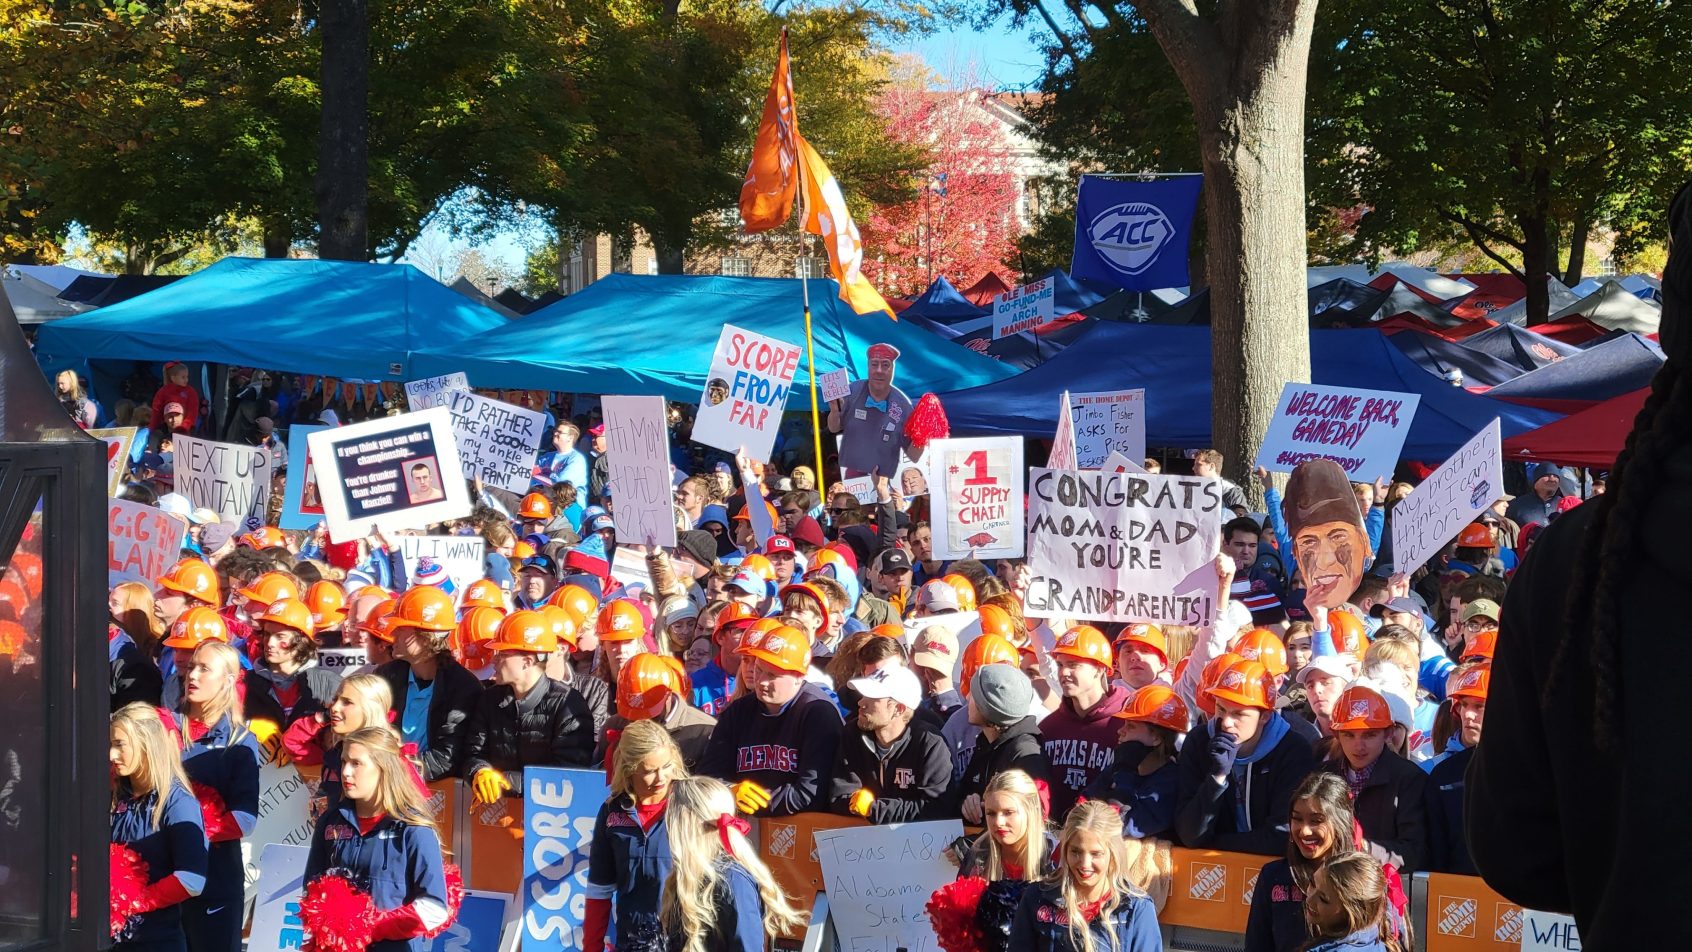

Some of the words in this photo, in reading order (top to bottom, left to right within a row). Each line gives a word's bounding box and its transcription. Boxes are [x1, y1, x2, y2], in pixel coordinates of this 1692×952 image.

[1100, 219, 1165, 244] ACC
[998, 287, 1053, 313] GO-FUND-ME
[1002, 289, 1020, 302] OLE
[1024, 280, 1046, 295] MISS
[1000, 315, 1043, 336] MANNING
[1012, 306, 1038, 323] ARCH
[727, 333, 799, 380] SCORE
[413, 394, 433, 411] NO
[731, 370, 789, 411] FROM
[451, 392, 475, 414] I'D
[478, 402, 533, 437] RATHER
[729, 400, 768, 431] FAR
[1071, 405, 1104, 423] Jimbo
[1110, 404, 1134, 421] Fisher
[1285, 390, 1361, 420] WELCOME
[1358, 398, 1403, 429] BACK,
[449, 411, 481, 434] TAKE
[480, 424, 491, 440] A
[1077, 424, 1106, 438] ASKS
[1114, 422, 1129, 435] For
[1292, 417, 1370, 450] GAMEDAY
[344, 445, 359, 457] you
[358, 441, 379, 453] think
[378, 438, 394, 450] you
[393, 435, 409, 446] can
[408, 432, 422, 442] win
[422, 431, 430, 440] a
[464, 437, 481, 457] my
[489, 445, 522, 463] ankle
[1104, 437, 1129, 455] Pics
[178, 439, 228, 475] NEXT
[236, 450, 266, 478] UP
[475, 456, 485, 466] be
[489, 461, 497, 469] a
[500, 461, 532, 479] TEXAS
[368, 469, 398, 483] drunker
[481, 467, 512, 490] FAN!
[1393, 497, 1424, 528] My
[1429, 431, 1491, 499] brother
[179, 475, 265, 521] MONTANA
[351, 488, 369, 499] than
[369, 482, 397, 495] Johnny
[959, 486, 1011, 505] SUPPLY
[1034, 472, 1221, 512] CONGRATS
[1395, 501, 1440, 549] thinks
[1460, 447, 1497, 492] can't
[958, 504, 1005, 525] CHAIN
[1029, 512, 1106, 540] MOM
[1127, 519, 1198, 545] DAD
[445, 541, 482, 560] WANT
[1071, 541, 1162, 570] YOU'RE
[1400, 529, 1429, 574] get
[1026, 576, 1212, 627] GRANDPARENTS!
[317, 652, 366, 667] Texas
[1045, 739, 1088, 767] TEXAS
[1087, 742, 1115, 772] A&M
[822, 835, 886, 864] Texas
[525, 778, 574, 948] SCORE
[1194, 866, 1209, 881] THE
[833, 873, 924, 900] Alabama
[1190, 864, 1226, 898] HOME
[1203, 879, 1225, 900] DEPOT
[865, 903, 927, 928] State
[1438, 898, 1477, 934] HOME
[1442, 901, 1458, 916] THE
[1500, 907, 1515, 922] THE
[1452, 914, 1475, 936] DEPOT
[1495, 911, 1524, 942] HOM
